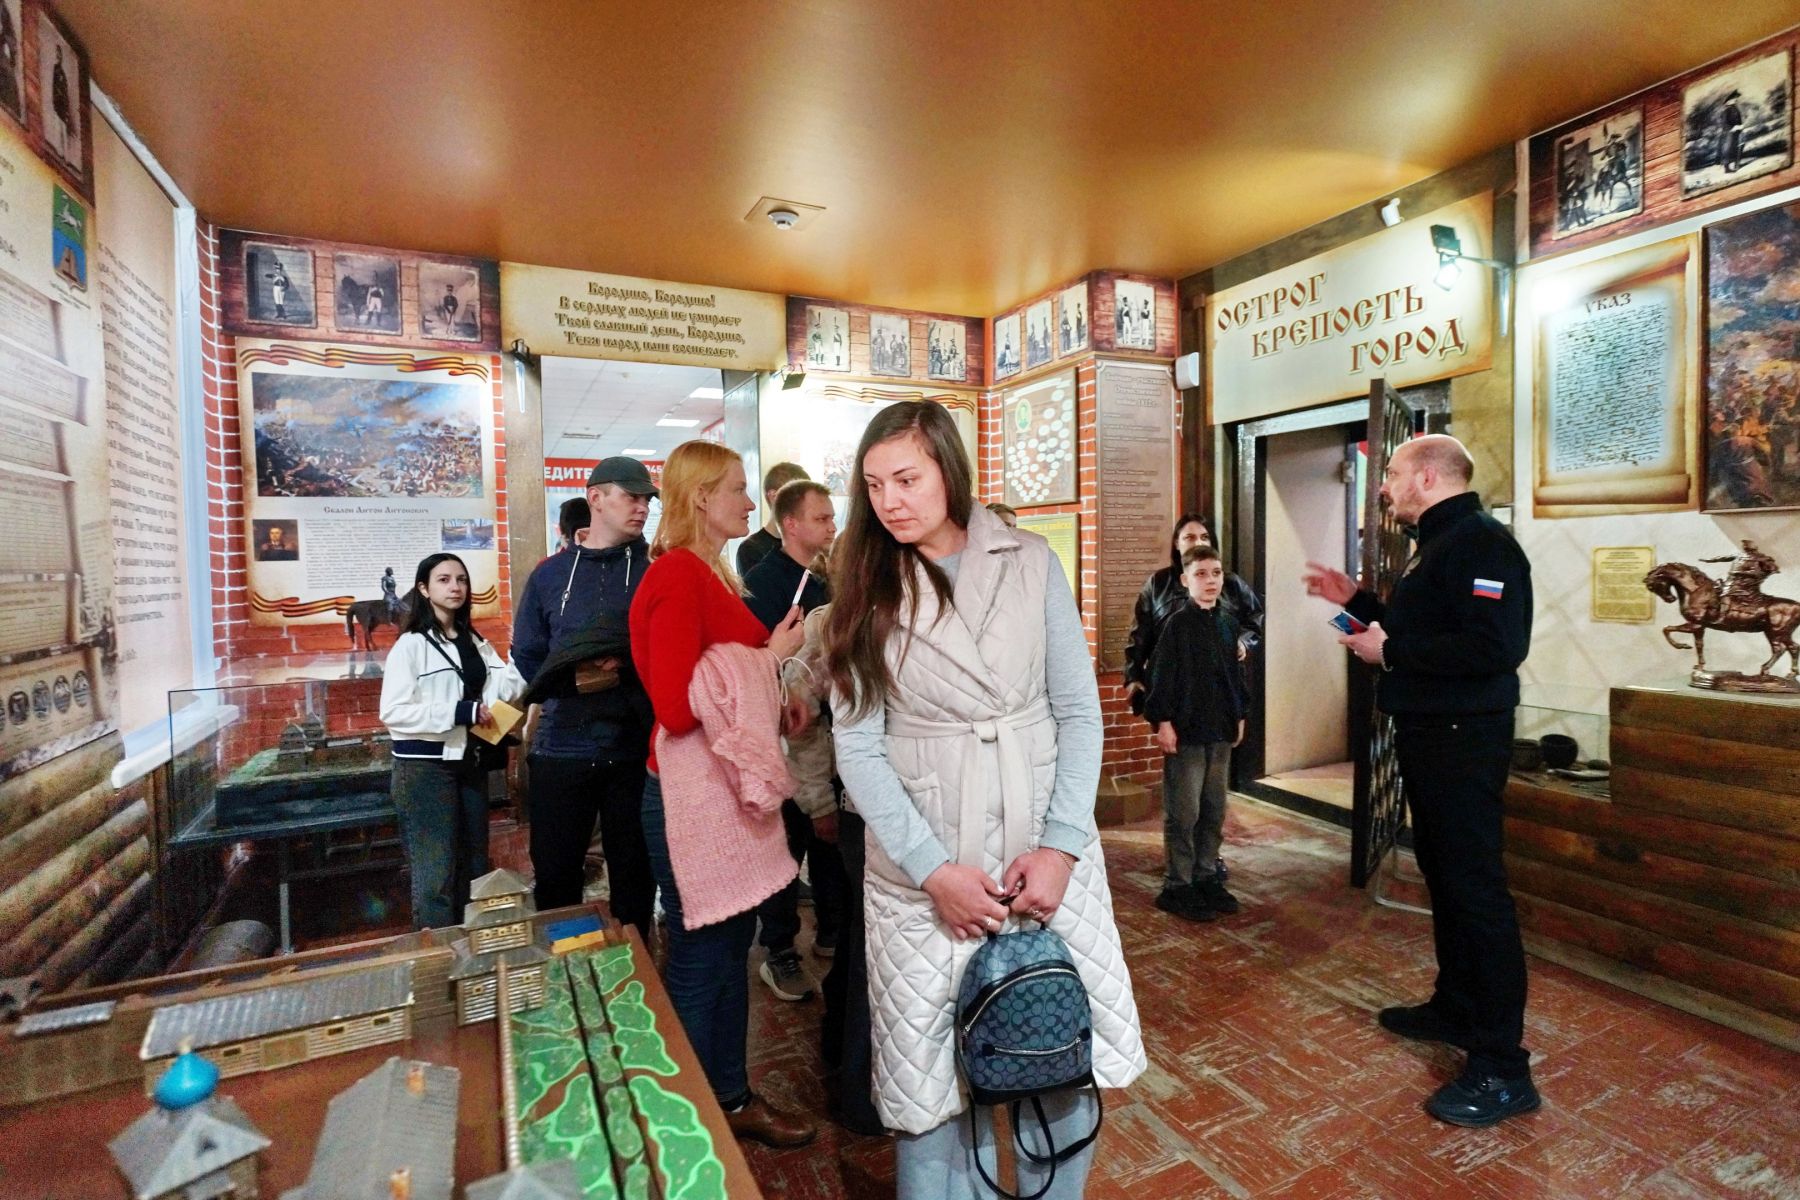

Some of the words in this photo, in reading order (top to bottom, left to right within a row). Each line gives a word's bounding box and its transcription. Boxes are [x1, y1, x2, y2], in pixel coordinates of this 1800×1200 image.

[559, 296, 570, 309] В
[573, 300, 626, 319] сердцах
[628, 307, 669, 320] людей
[671, 311, 687, 322] не
[1217, 273, 1326, 331] ОСТРОГ
[1251, 285, 1424, 358] КРЕПОСТЬ
[1351, 318, 1465, 373] ГОРОД
[544, 466, 592, 481] ЕДИТЕ
